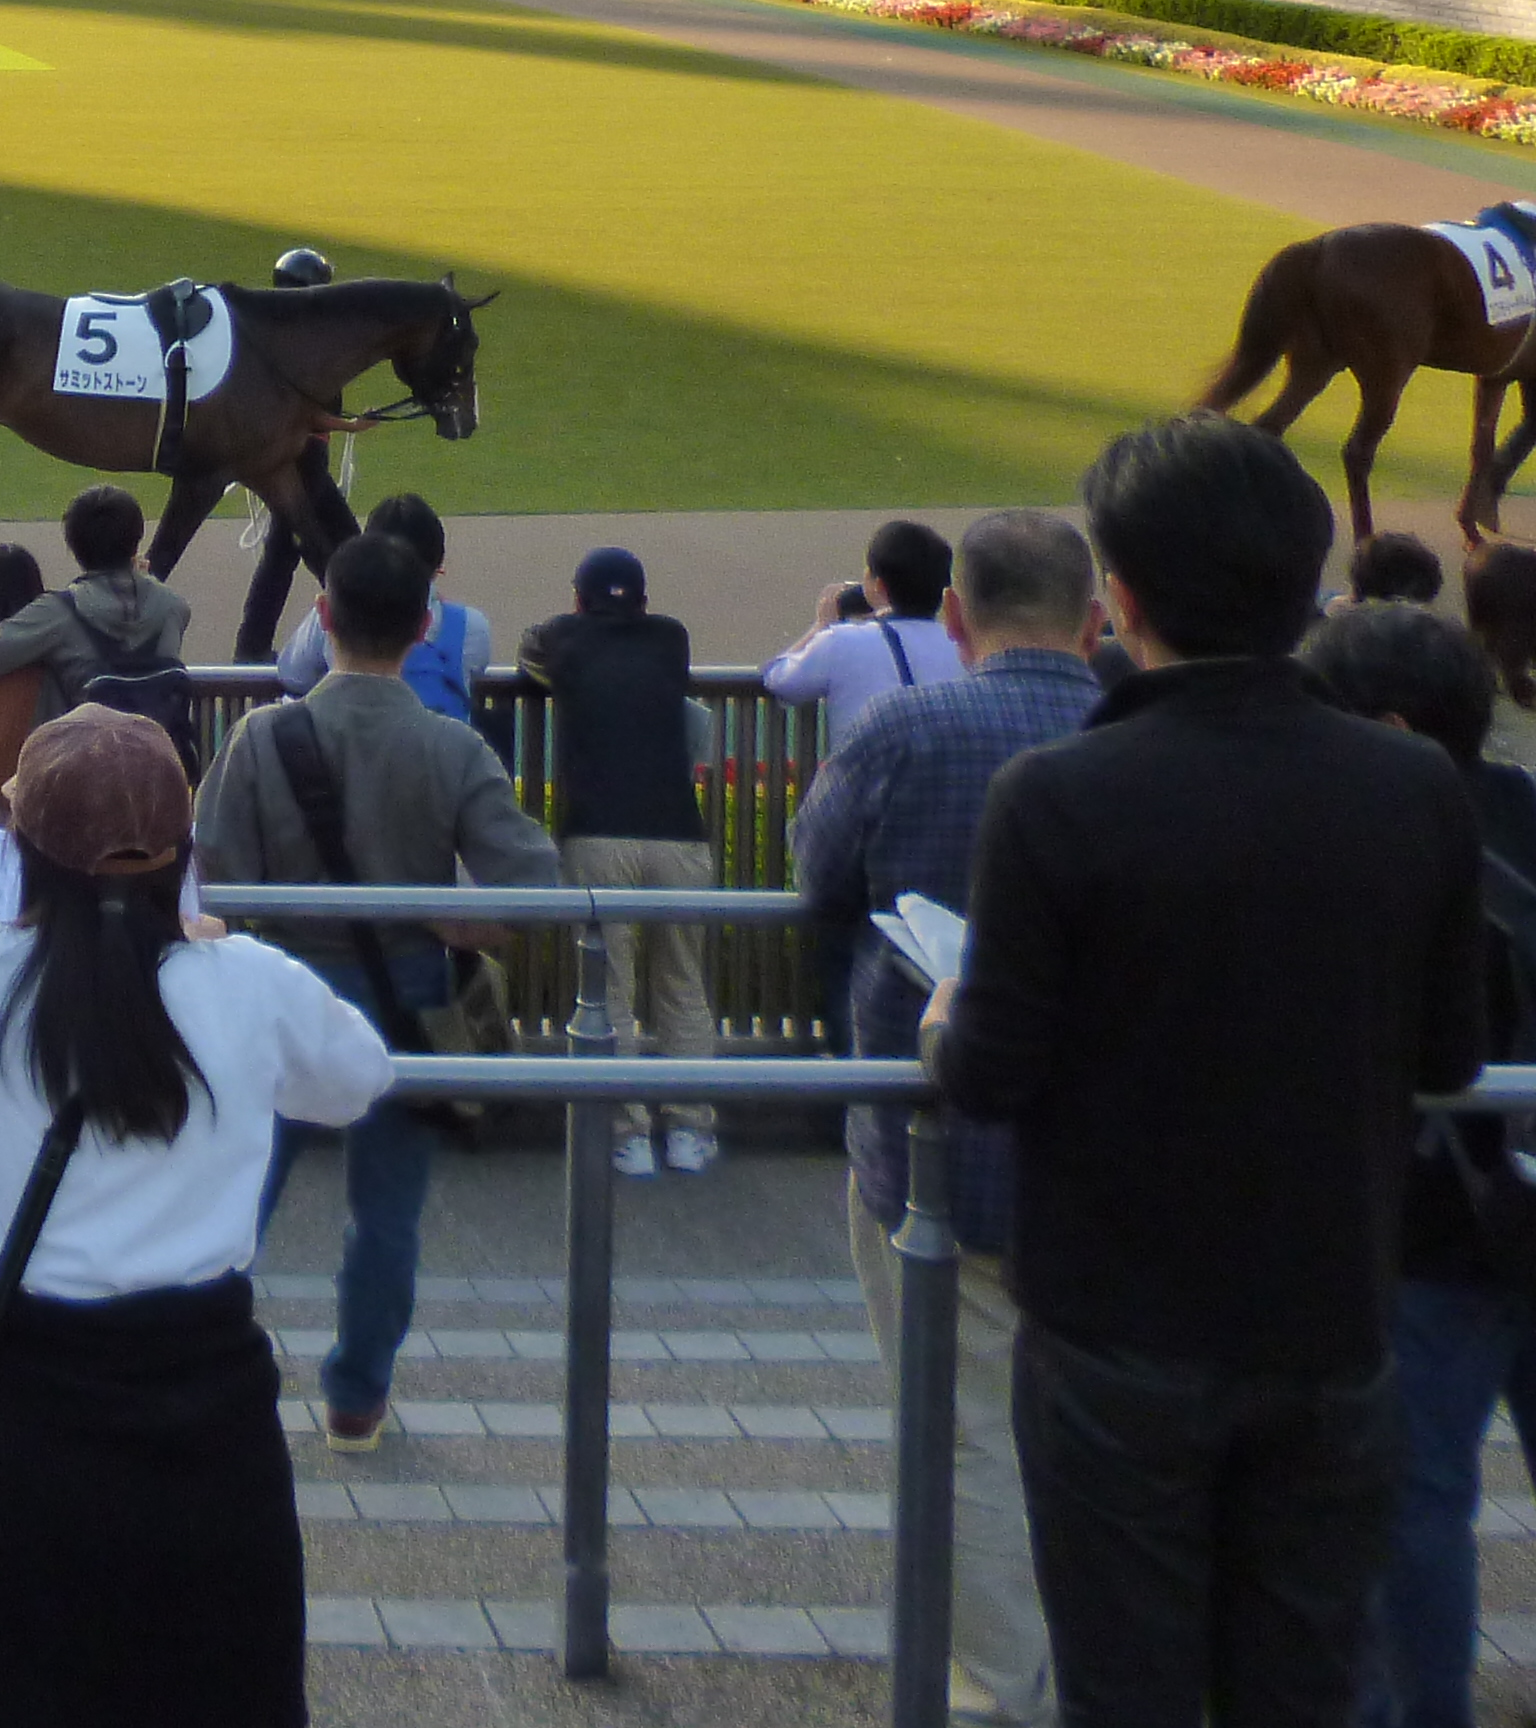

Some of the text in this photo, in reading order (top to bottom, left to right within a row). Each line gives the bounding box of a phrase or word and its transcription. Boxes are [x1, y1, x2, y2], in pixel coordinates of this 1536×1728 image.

[1483, 240, 1516, 291] 4
[75, 311, 118, 366] 5
[58, 370, 148, 393] サミットストーン
